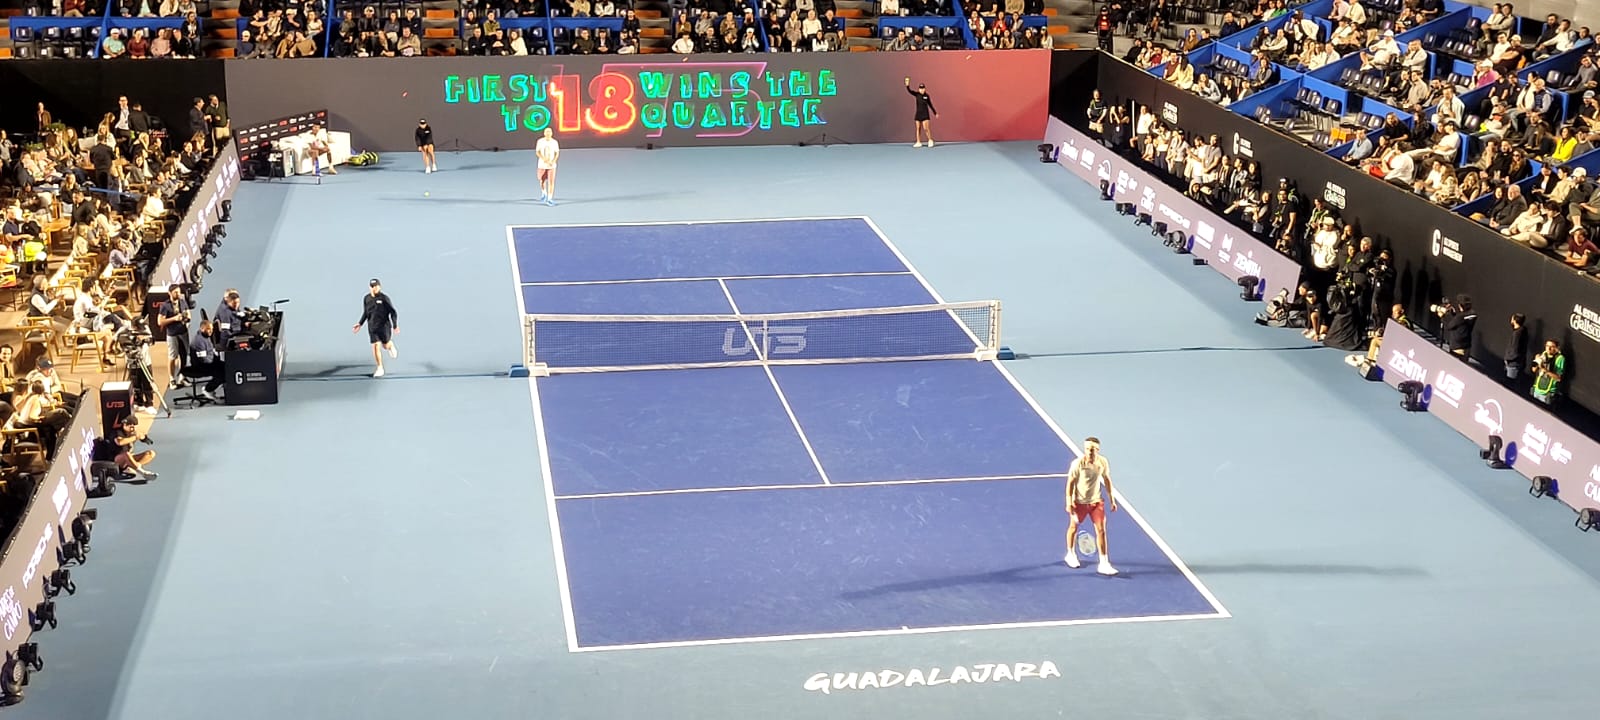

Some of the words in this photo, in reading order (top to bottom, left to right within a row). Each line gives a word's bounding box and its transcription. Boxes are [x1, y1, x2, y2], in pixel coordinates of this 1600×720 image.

[444, 74, 548, 102] FIRST
[639, 71, 750, 98] WINS
[765, 69, 836, 96] THE
[549, 72, 636, 132] 18
[640, 99, 827, 129] QUARTER
[501, 104, 551, 132] TO
[722, 325, 809, 356] UTS
[235, 371, 243, 385] G
[1388, 349, 1428, 384] ZENITH
[803, 660, 1061, 694] GUADALAJARA
